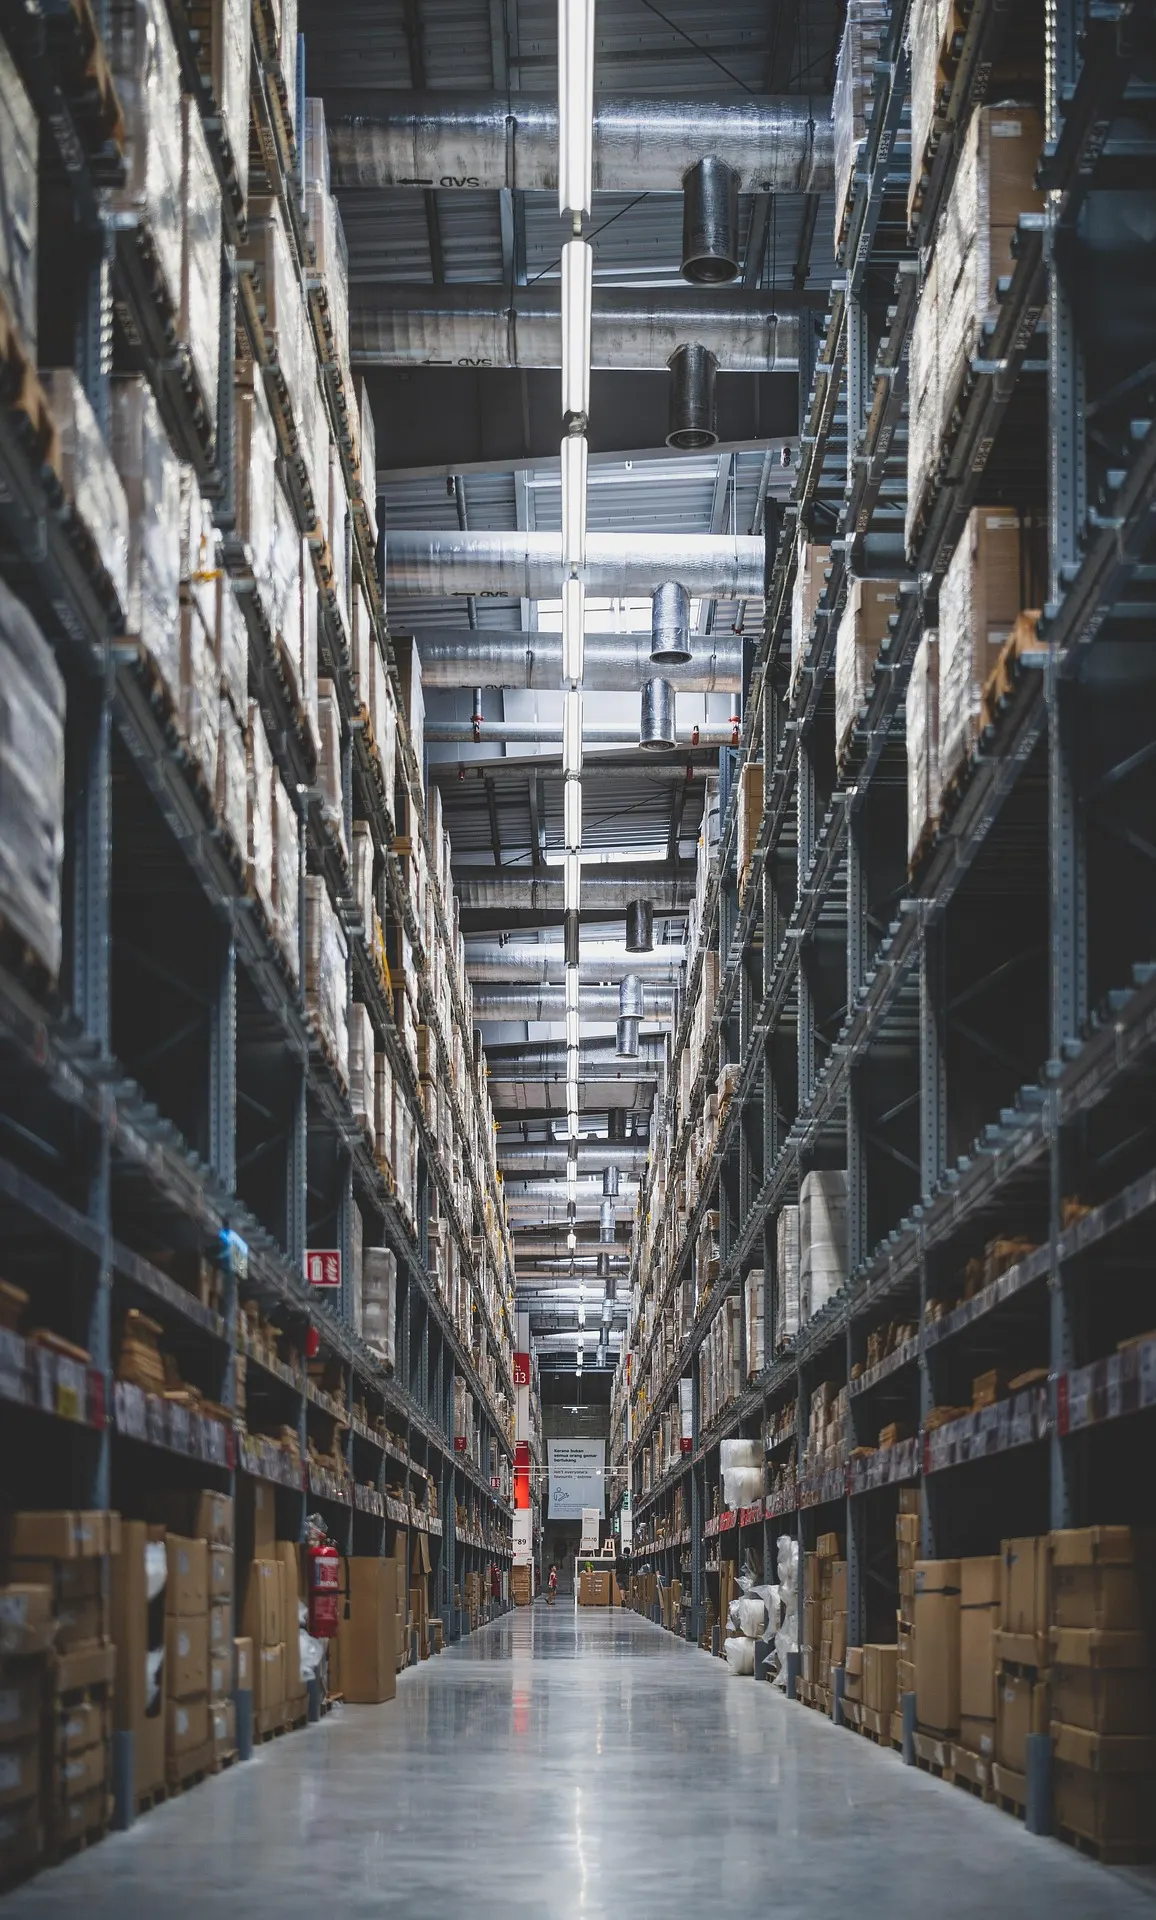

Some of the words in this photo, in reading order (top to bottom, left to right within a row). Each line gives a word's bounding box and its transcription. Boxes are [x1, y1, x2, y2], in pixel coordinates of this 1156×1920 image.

[440, 176, 480, 187] SAD
[458, 358, 493, 367] SAD
[515, 1372, 526, 1383] 13
